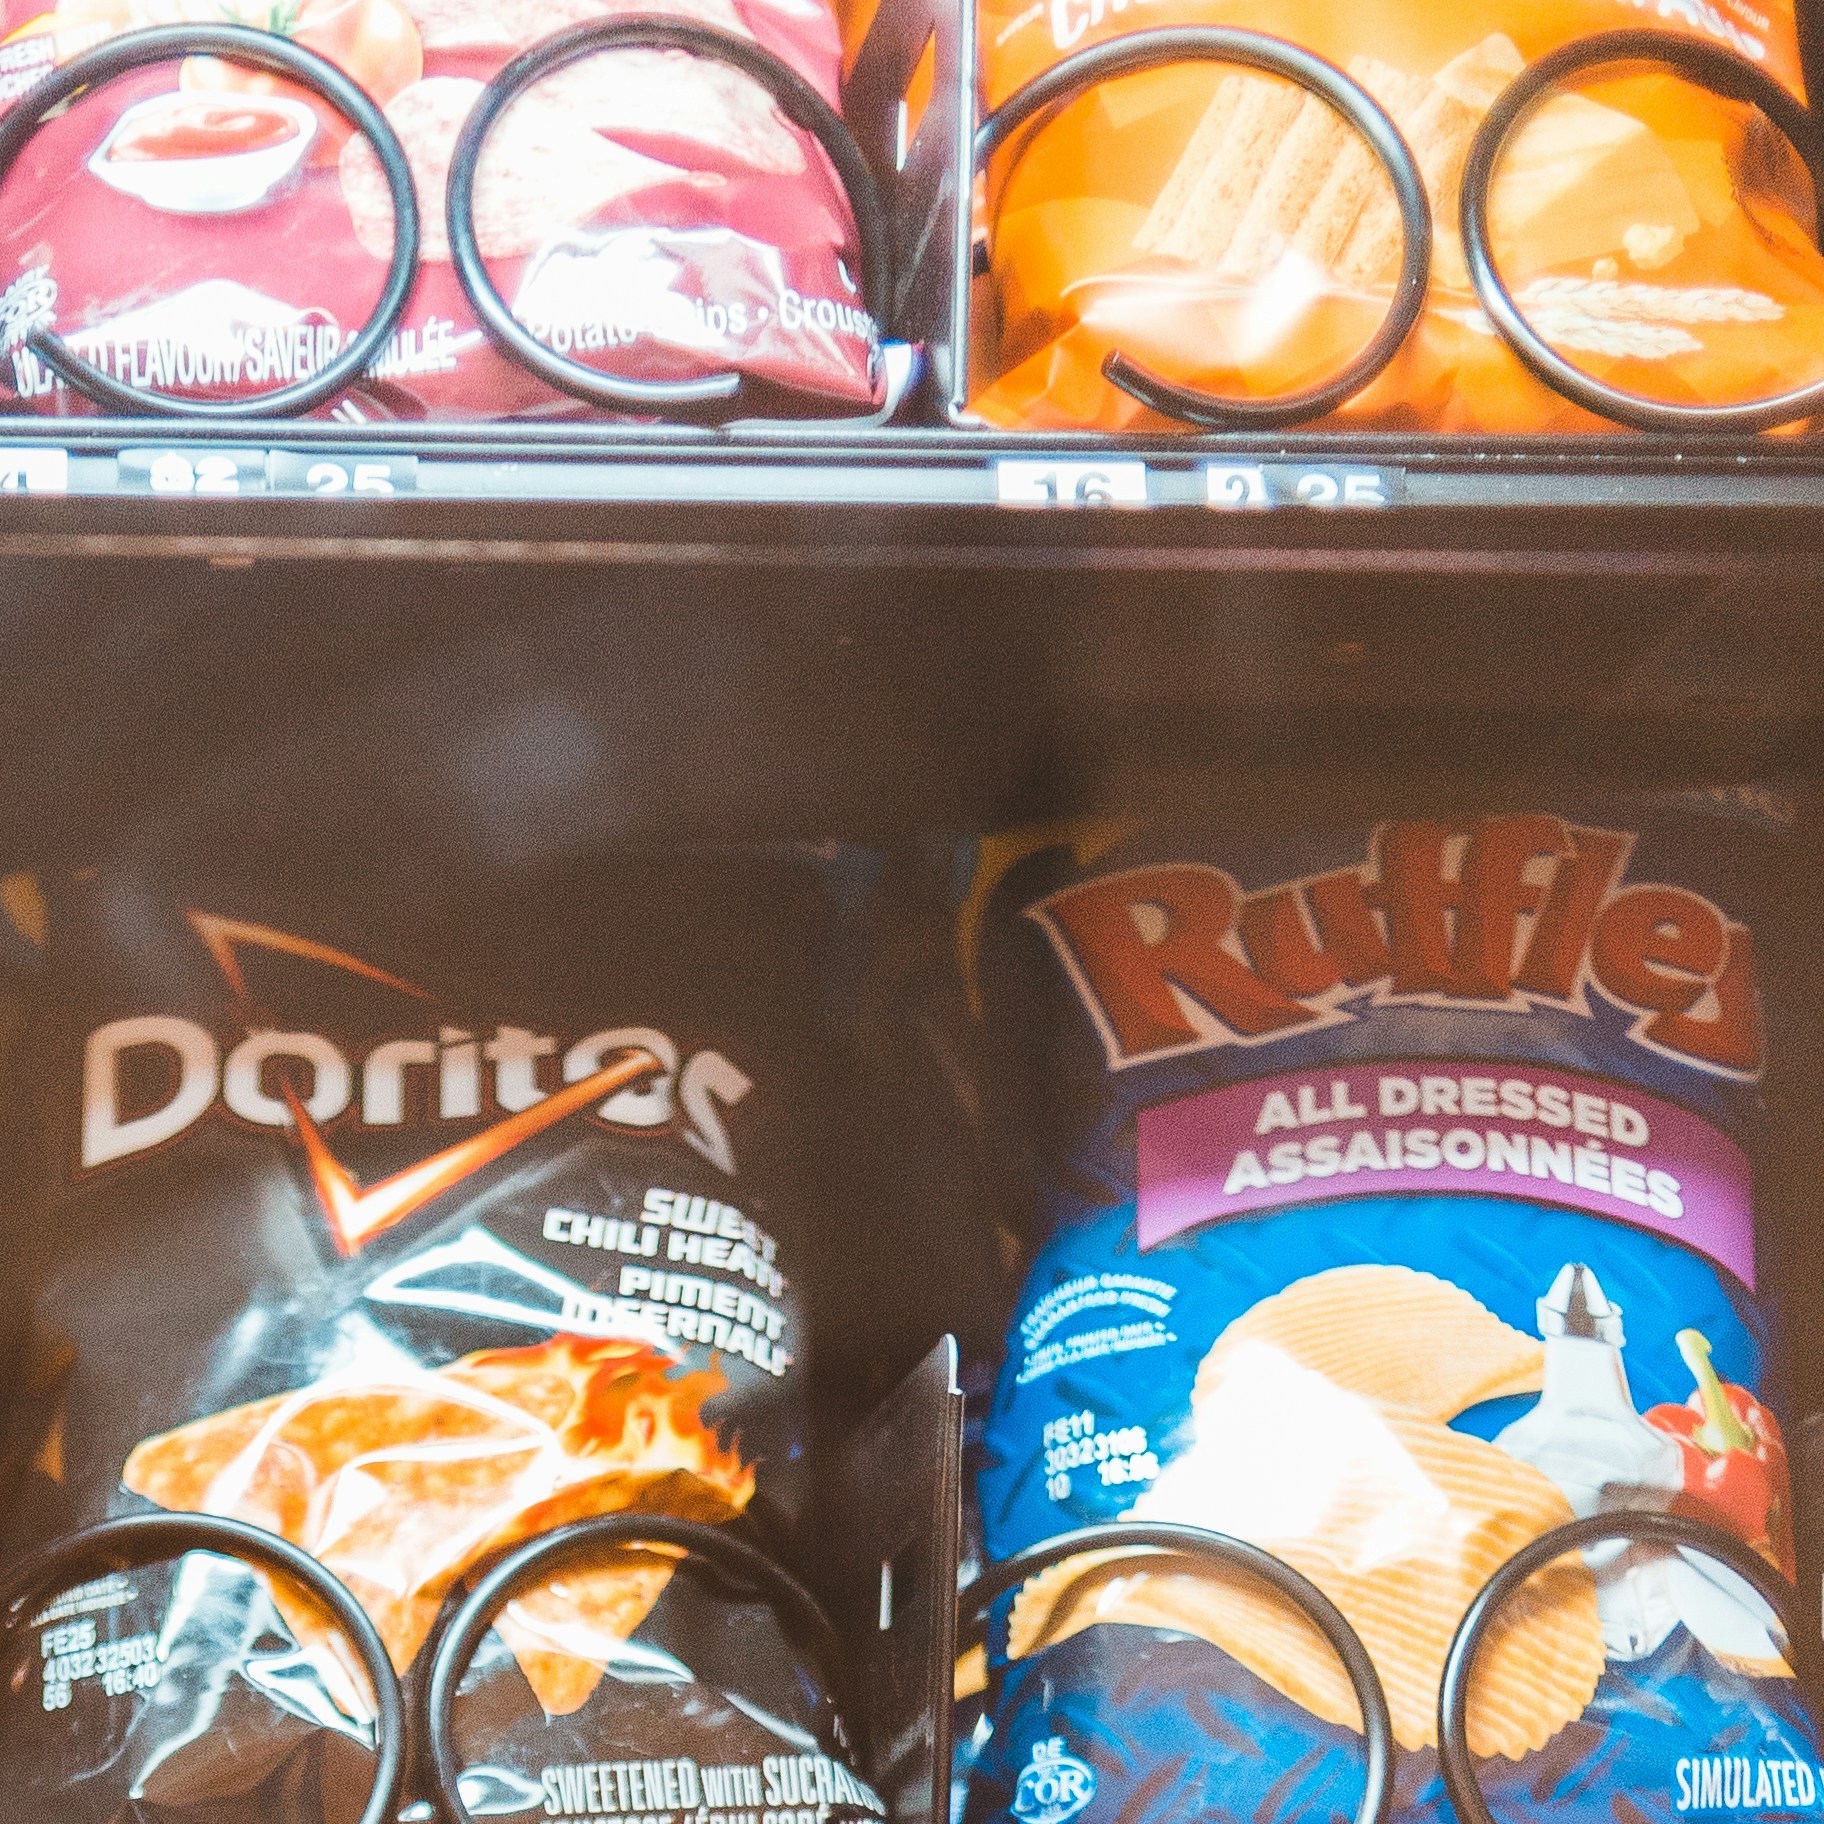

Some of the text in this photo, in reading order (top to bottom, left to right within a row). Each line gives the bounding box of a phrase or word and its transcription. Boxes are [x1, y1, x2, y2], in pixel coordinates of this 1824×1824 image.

[80, 1014, 754, 1176] Doritos
[1253, 1074, 1649, 1148] ALL DRESSED
[1223, 1128, 1685, 1220] ASSAISONNÉES
[542, 1206, 660, 1257] CHILI
[619, 1263, 788, 1341] PIMENT
[541, 1757, 761, 1815] SWEETENED WITH
[1675, 1757, 1815, 1812] SIMULATED
